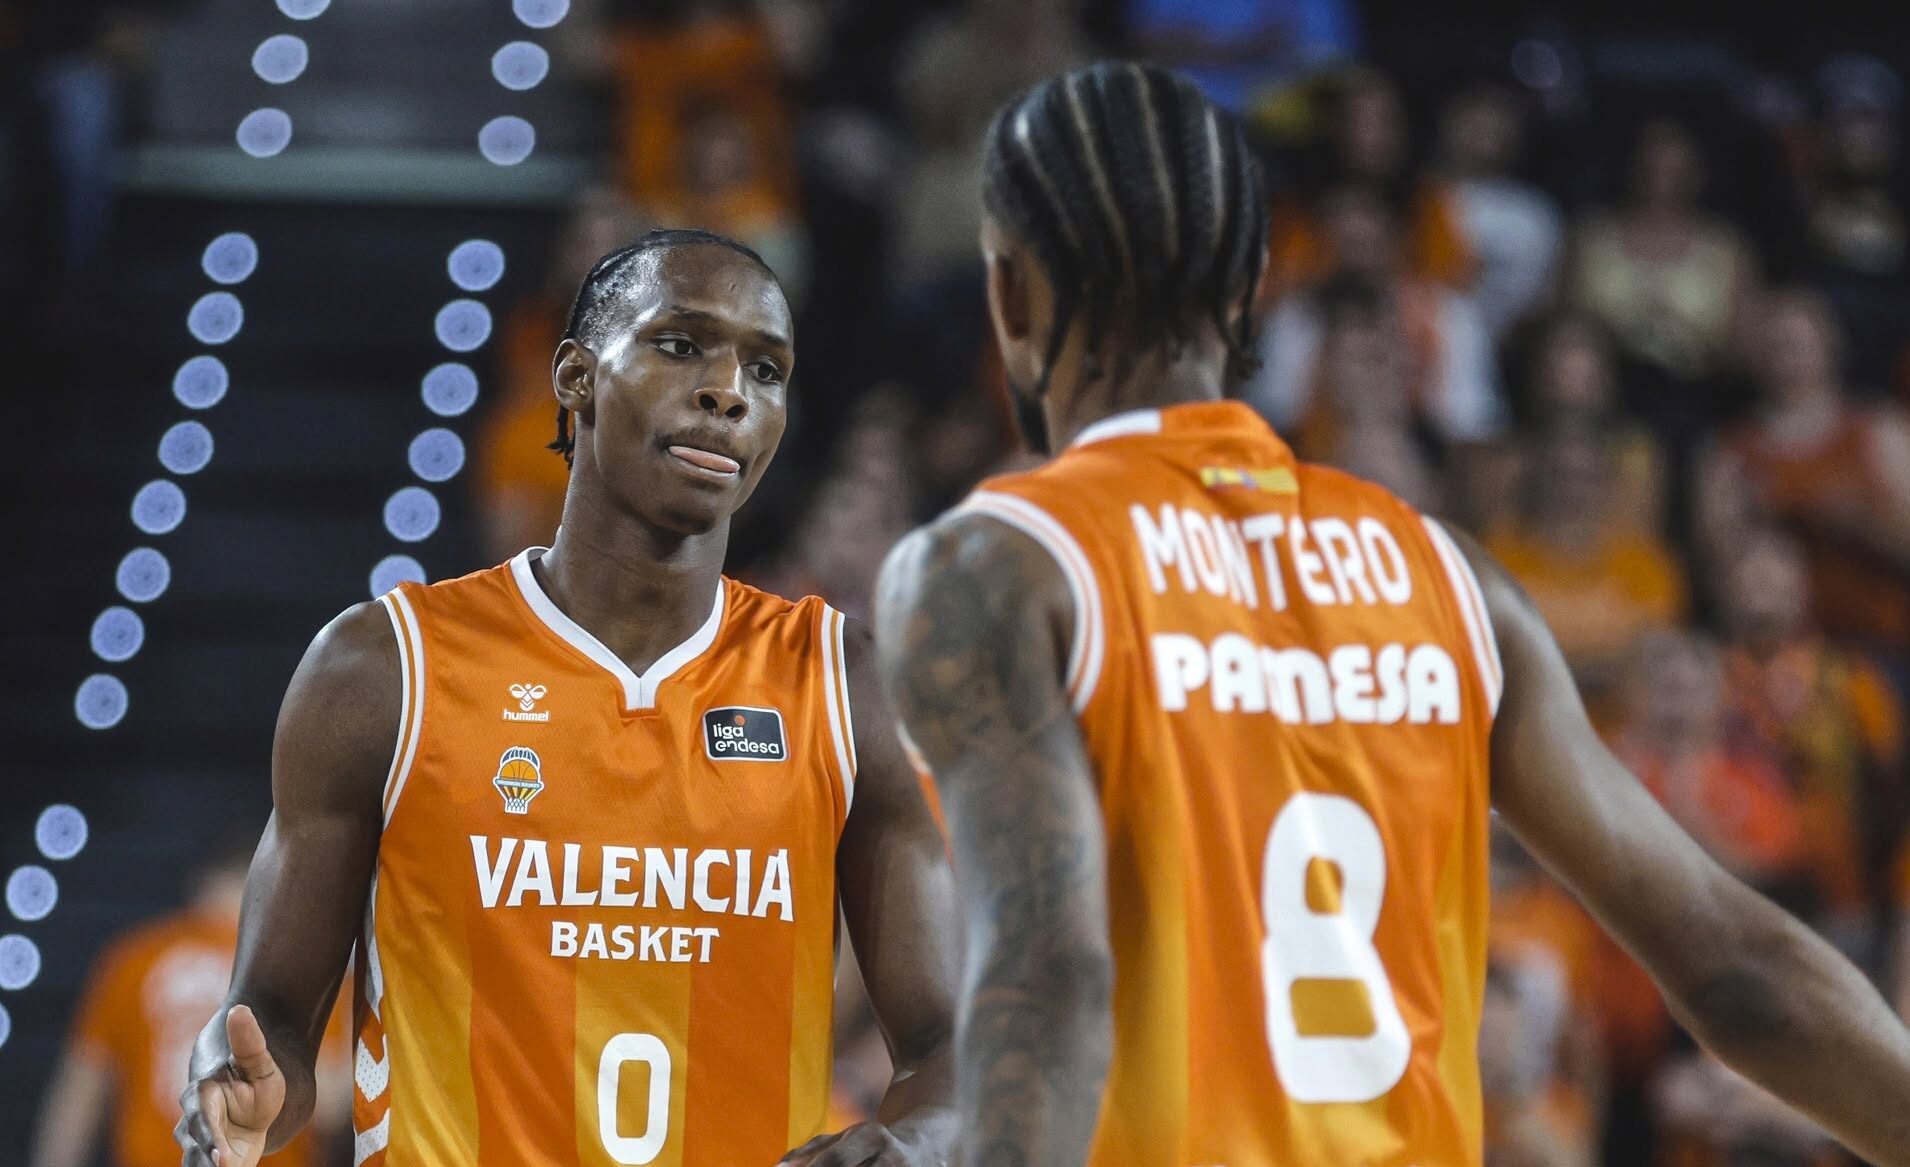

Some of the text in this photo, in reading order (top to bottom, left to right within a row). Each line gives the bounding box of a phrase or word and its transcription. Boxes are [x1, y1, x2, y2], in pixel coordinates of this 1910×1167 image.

[1130, 503, 1412, 612] MONTERO
[503, 709, 549, 721] hummel
[1151, 632, 1461, 725] PAMESA
[713, 723, 744, 739] liga
[715, 739, 780, 754] endesa
[469, 834, 793, 921] VALENCIA
[550, 922, 720, 962] BASKET
[1261, 790, 1412, 1103] 8
[597, 1033, 671, 1165] 0
